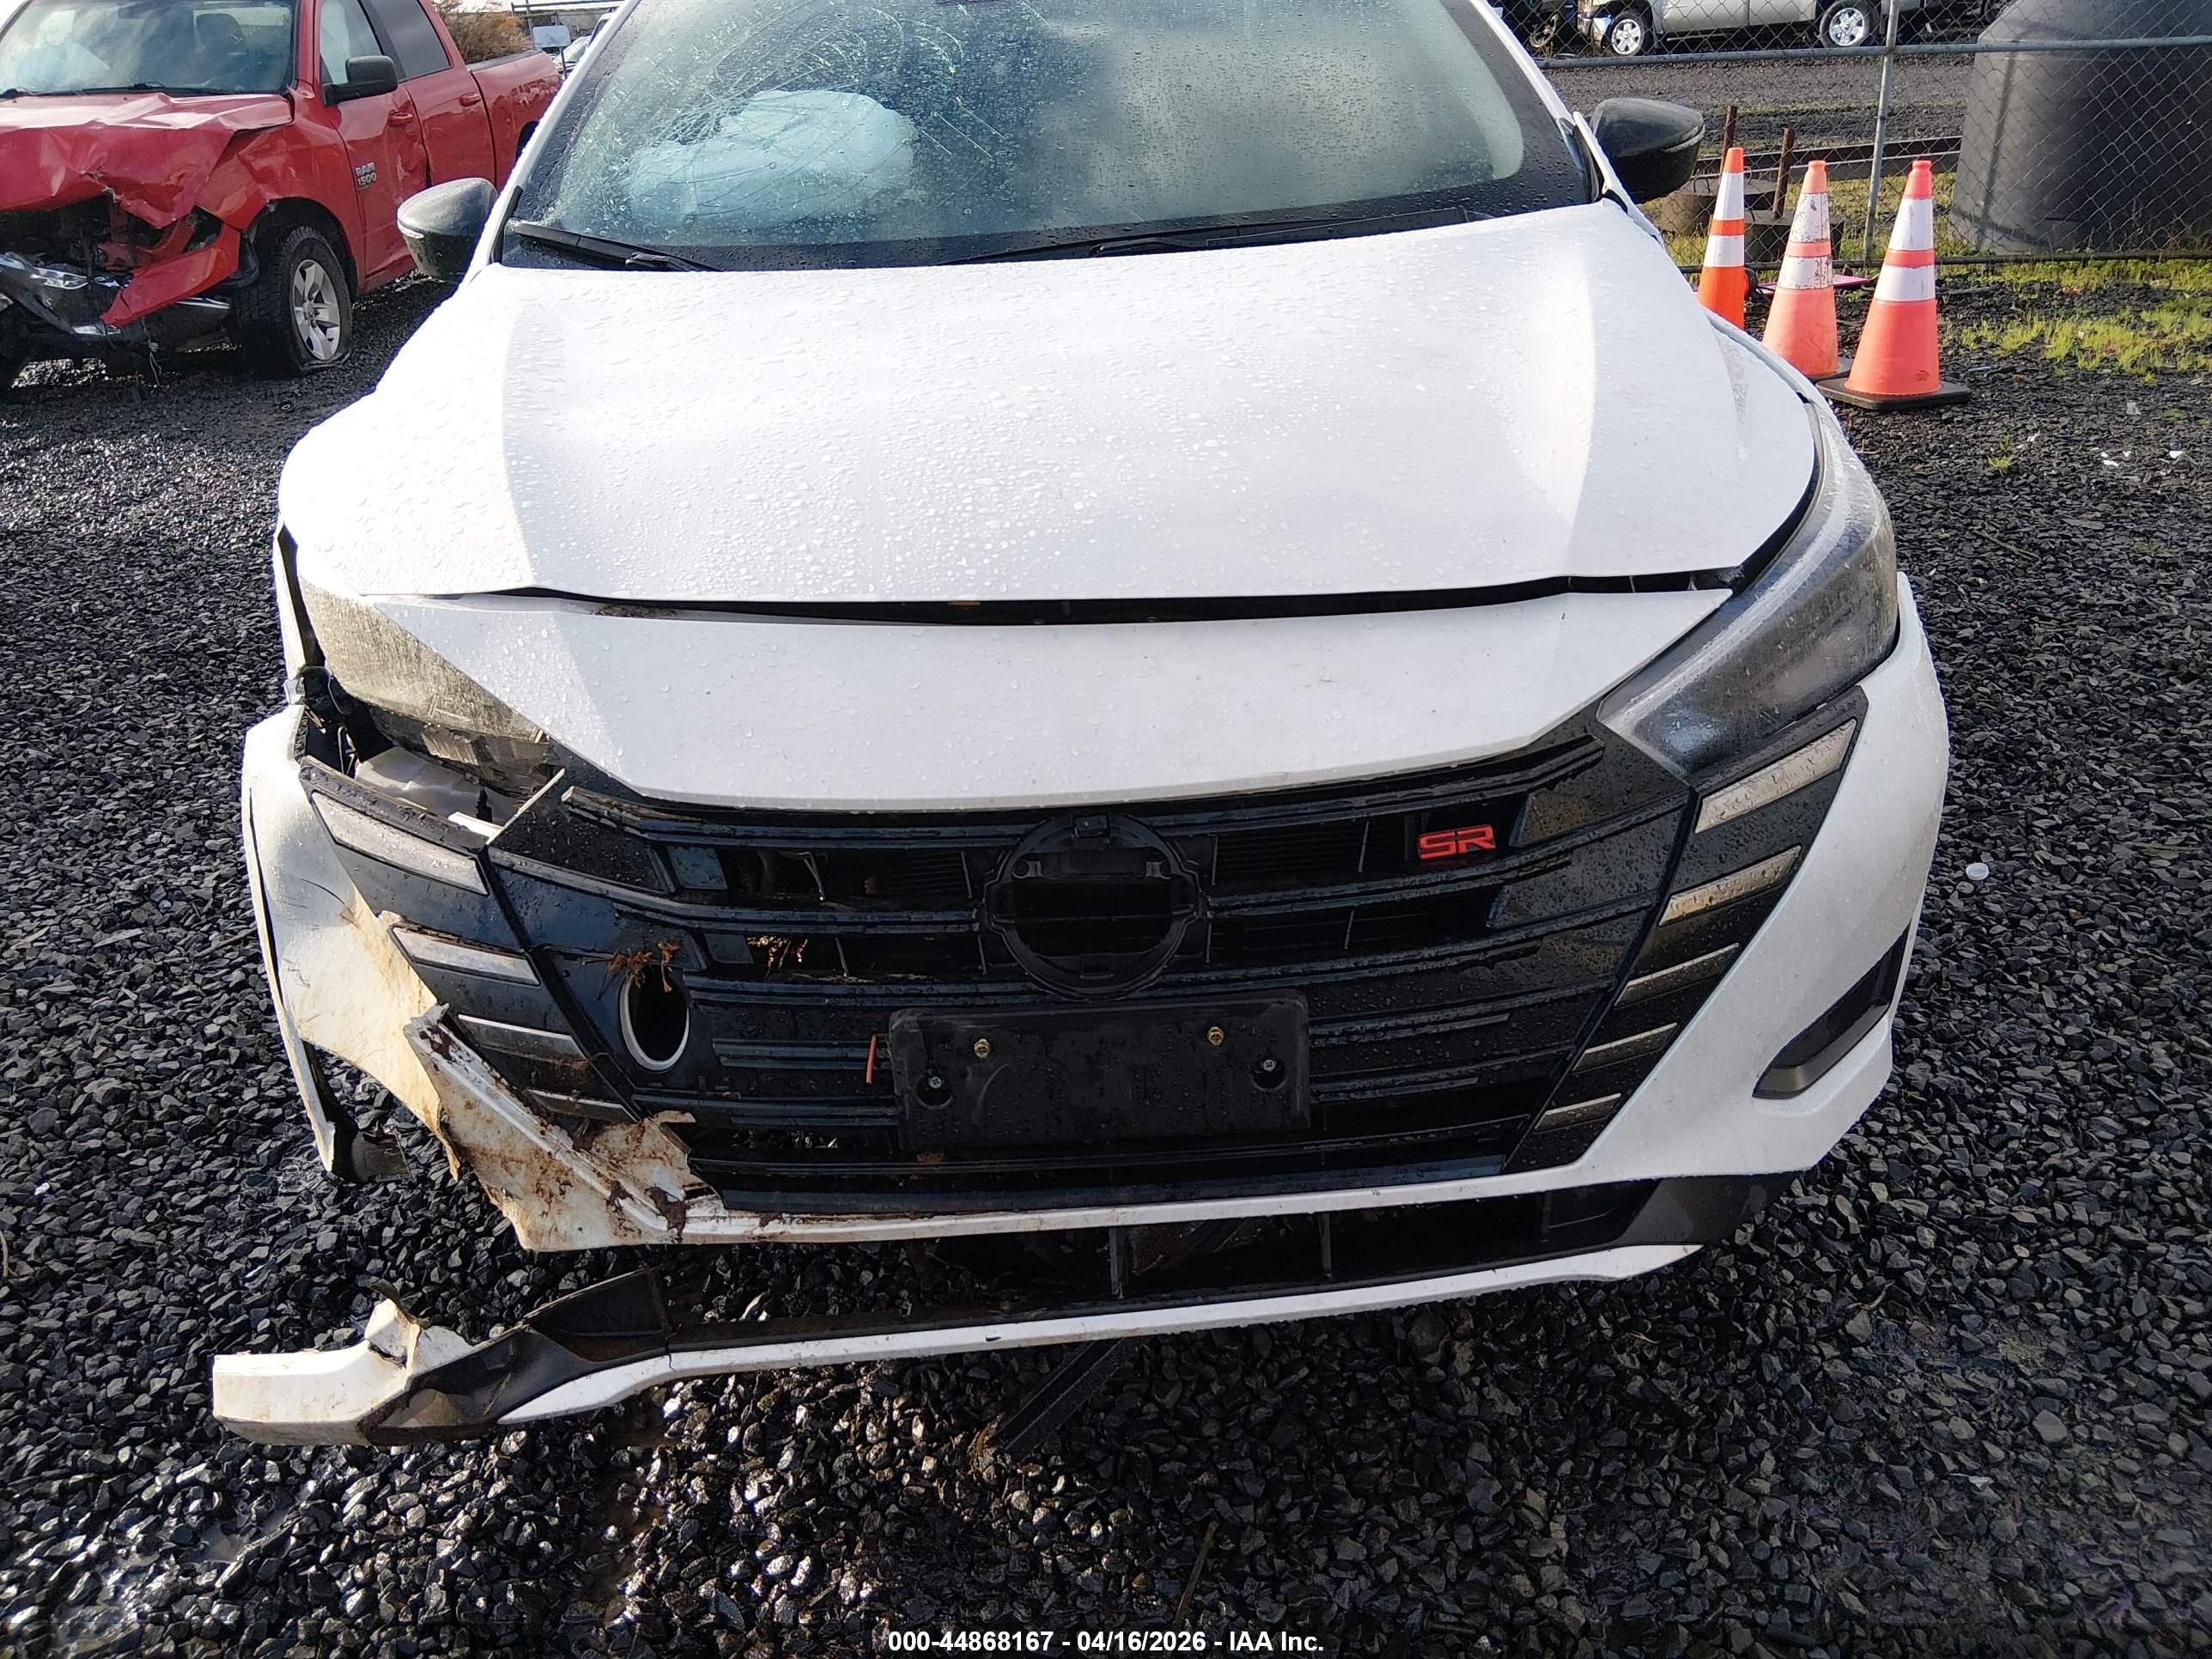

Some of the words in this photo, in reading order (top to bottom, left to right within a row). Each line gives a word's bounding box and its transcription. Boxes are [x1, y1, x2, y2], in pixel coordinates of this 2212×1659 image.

[356, 162, 375, 176] RAM
[357, 173, 377, 186] 1500
[1419, 825, 1496, 859] SR
